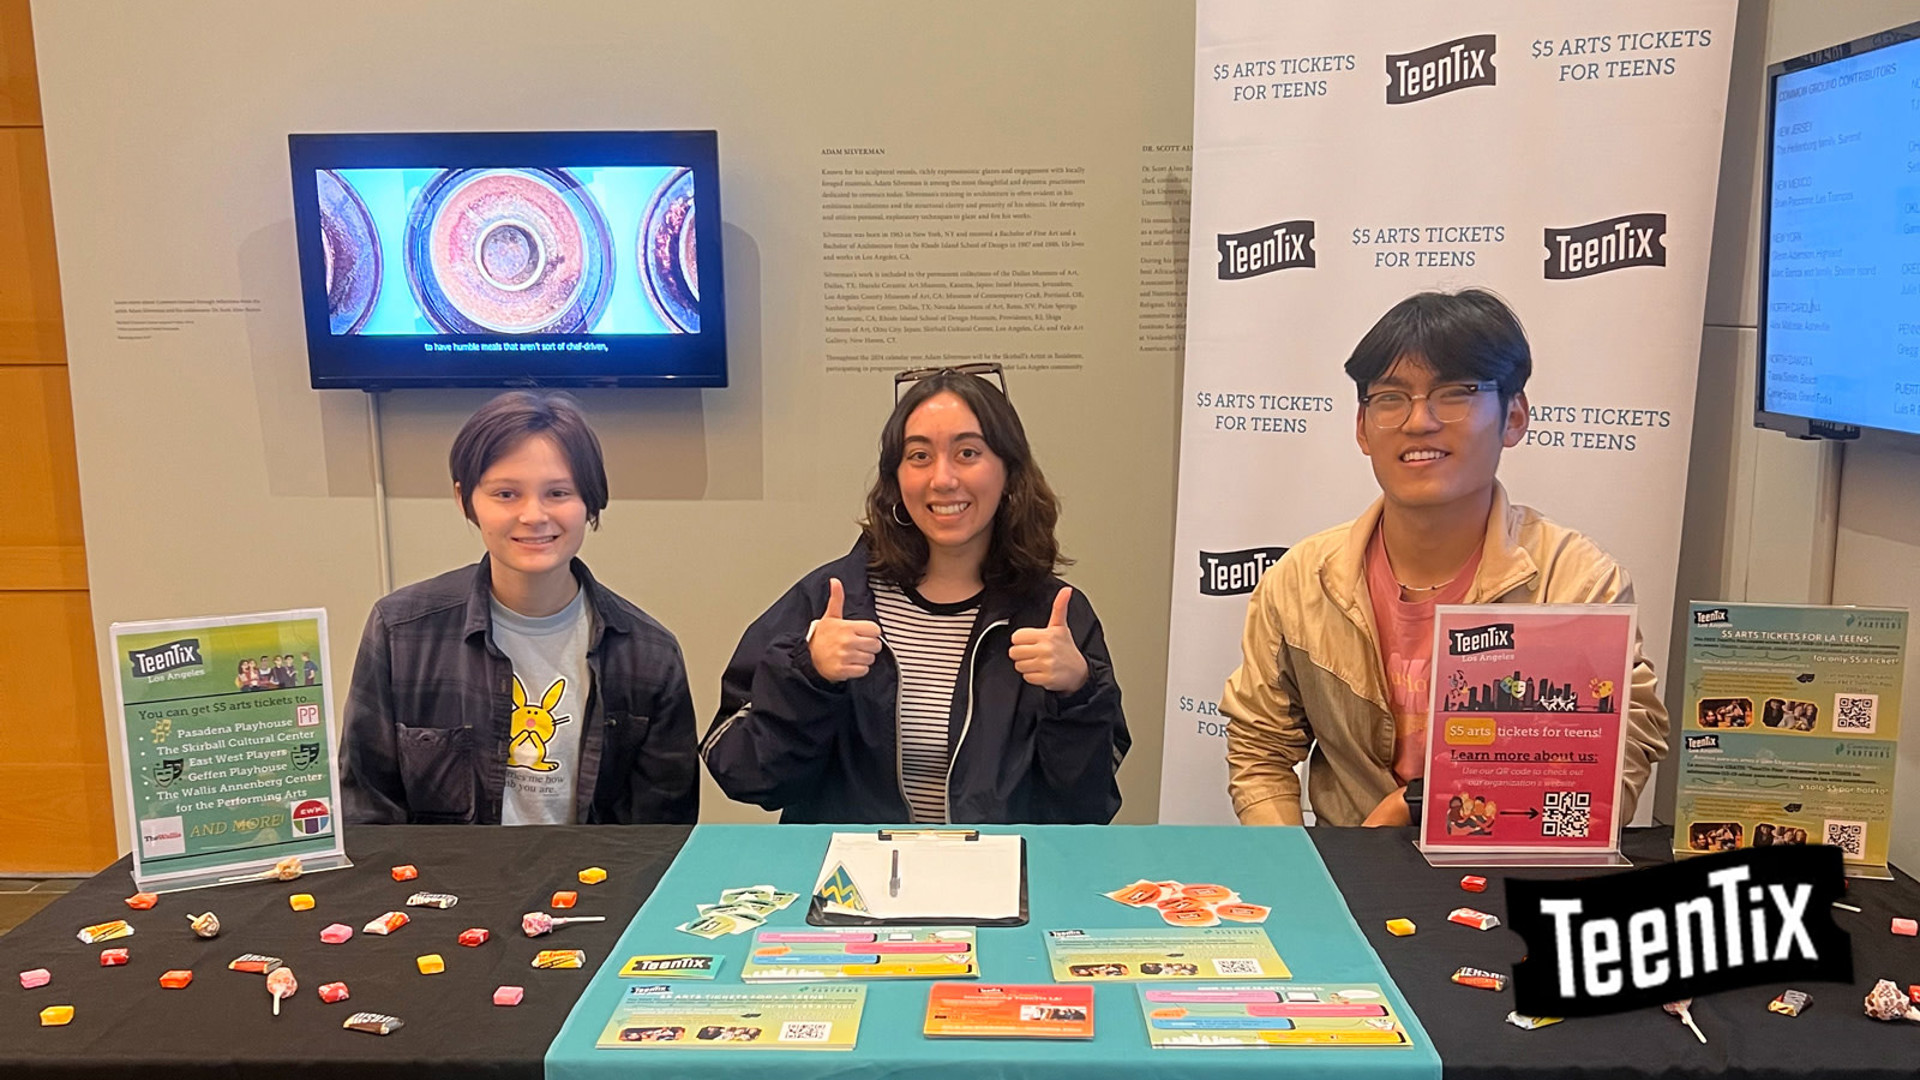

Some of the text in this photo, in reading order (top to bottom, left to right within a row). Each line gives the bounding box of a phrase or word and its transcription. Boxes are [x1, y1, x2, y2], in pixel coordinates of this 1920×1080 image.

[1532, 30, 1712, 59] $5 ARTS TICKETS
[1214, 55, 1356, 81] $5 ARTS TICKETS
[1396, 44, 1486, 97] TeenTix
[1559, 58, 1676, 82] FOR TEENS
[1234, 80, 1328, 101] FOR TEENS
[1352, 226, 1505, 246] $5 ARTS TICKETS
[1226, 228, 1306, 273] TeenTix
[1555, 221, 1654, 273] TeenTix
[1375, 251, 1476, 268] FOR TEENS
[425, 342, 608, 353] to have humble meals that aren't sort of chef-driven,
[1197, 391, 1333, 412] $5 ARTS TICKETS
[1215, 416, 1307, 434] FOR TEENS
[1529, 405, 1671, 427] ARTS TICKETS
[1526, 429, 1637, 451] FOR TEENS
[1697, 610, 1725, 624] TeenTix
[1455, 626, 1508, 653] TeenTix
[1735, 630, 1759, 639] ARTS
[1761, 631, 1801, 641] TICKETS
[1803, 632, 1822, 642] FOR
[1824, 634, 1837, 642] LA
[136, 643, 197, 674] TeenTix
[1462, 653, 1515, 663] Los Angeles
[147, 669, 206, 684] Los Angeles
[138, 709, 163, 720] You
[166, 708, 189, 717] can
[191, 704, 211, 717] get
[213, 702, 226, 713] $5
[229, 700, 252, 712] arts
[254, 696, 293, 708] tickets
[1179, 695, 1194, 712] $5
[177, 719, 293, 739] Pasadena Playhouse
[1197, 721, 1229, 738] FOR
[1450, 726, 1603, 739] $5 arts tickets for teens!
[156, 731, 316, 757] The Skirball Cultural Center
[188, 747, 288, 768] East West Players
[1450, 749, 1599, 762] Learn more about us:
[188, 763, 288, 783] Geffen Playhouse
[545, 774, 564, 785] how
[156, 772, 322, 802] The Wallis Annenberg Center
[517, 783, 537, 793] you
[175, 788, 308, 814] for the Performing Arts
[190, 821, 229, 838] AND
